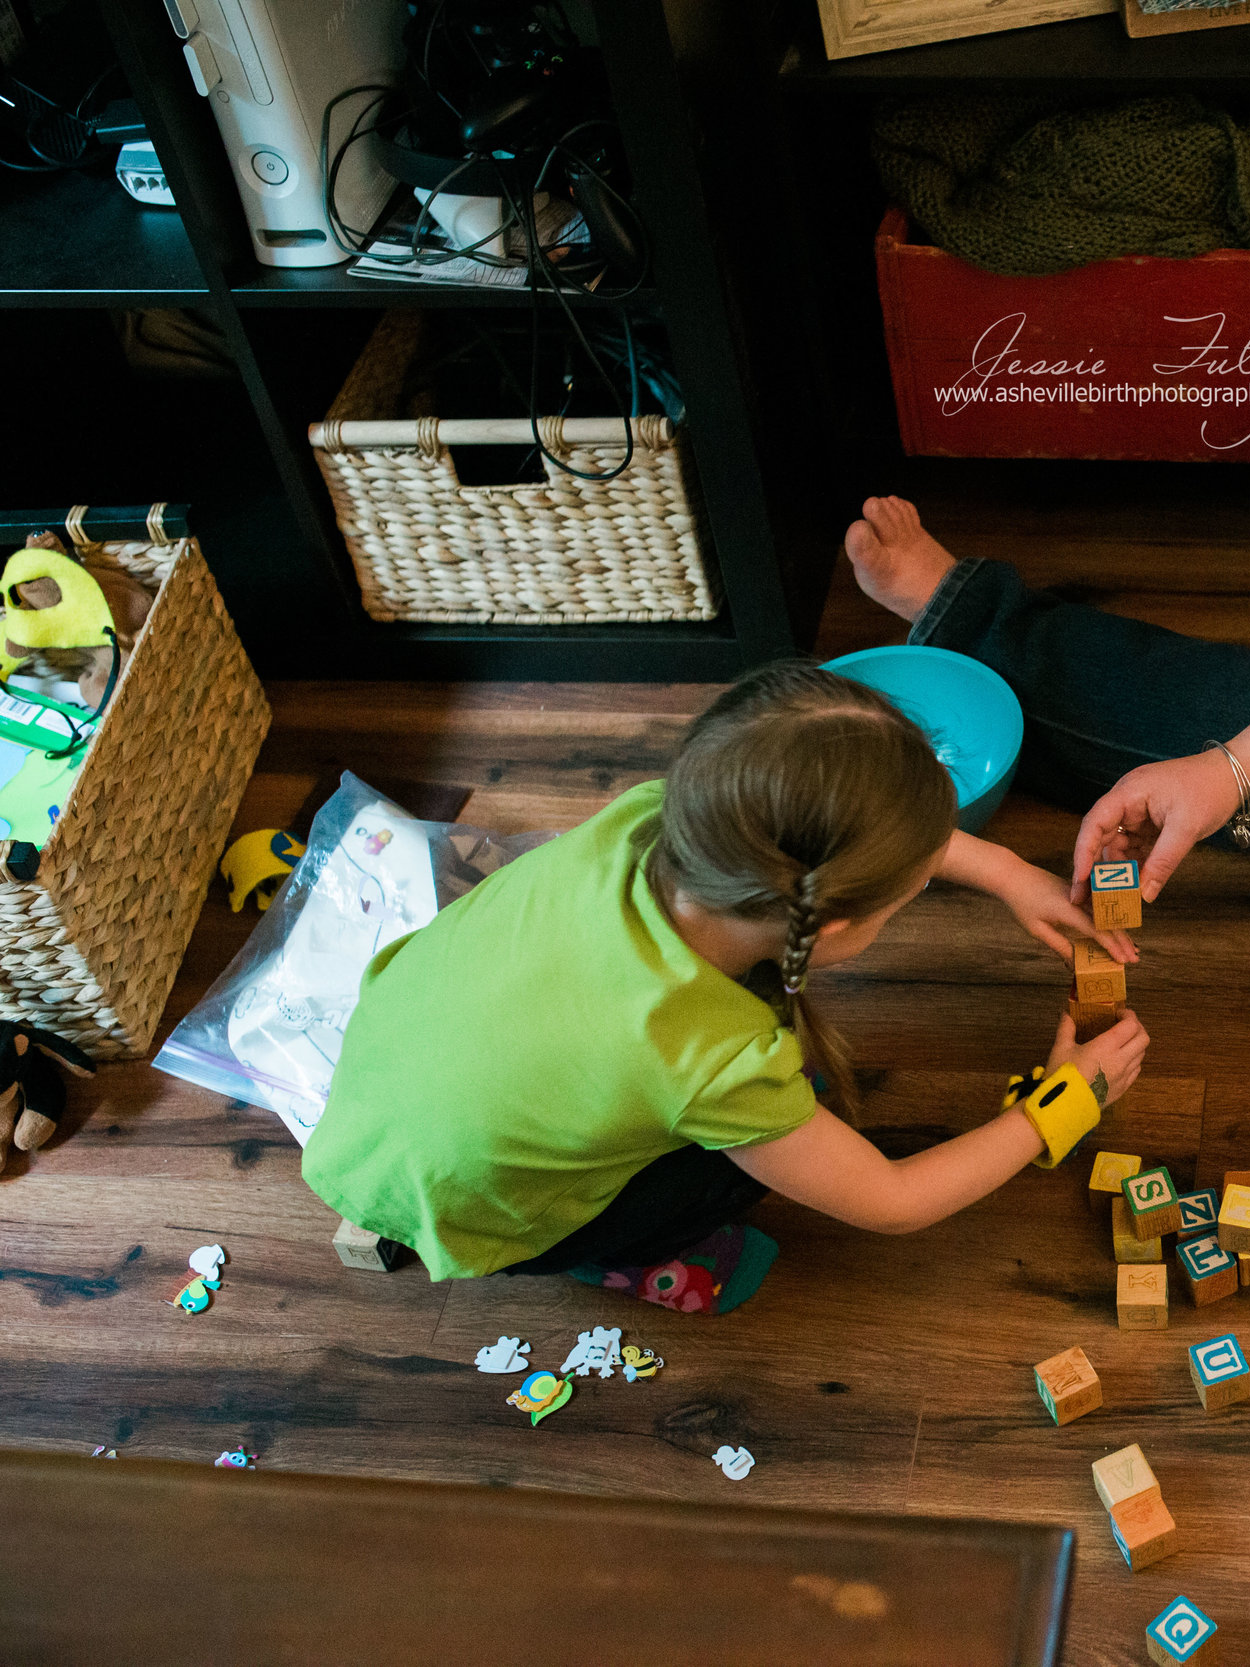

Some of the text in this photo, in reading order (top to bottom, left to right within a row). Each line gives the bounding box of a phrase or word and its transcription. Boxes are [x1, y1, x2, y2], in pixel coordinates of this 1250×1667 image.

[1135, 1180, 1164, 1202] S
[1203, 1342, 1238, 1372] U
[1165, 1612, 1198, 1649] Q
